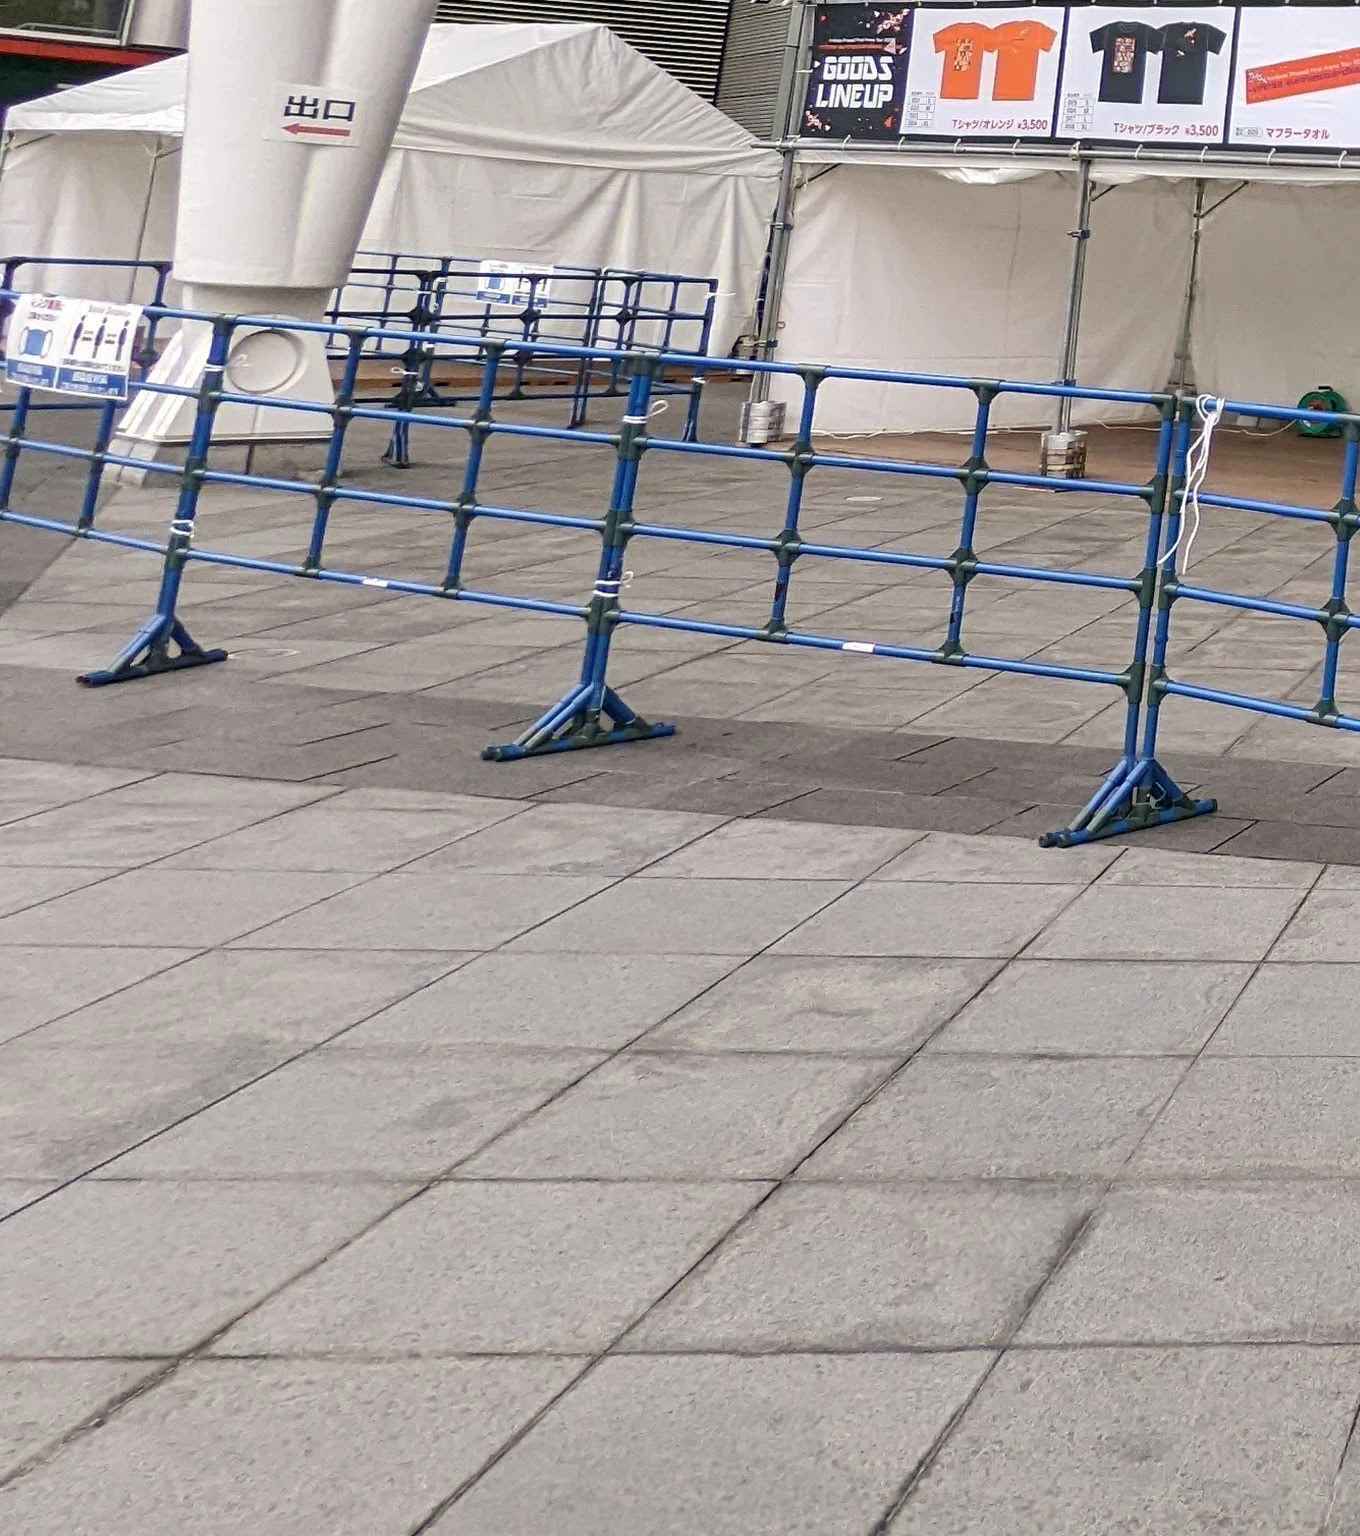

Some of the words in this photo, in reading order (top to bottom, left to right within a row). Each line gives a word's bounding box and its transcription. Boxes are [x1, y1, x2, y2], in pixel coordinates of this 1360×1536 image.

[823, 55, 894, 81] GOODS
[815, 83, 894, 109] LINEUP
[284, 95, 356, 122] 出口
[1017, 119, 1048, 130] ¥3,500
[1185, 124, 1219, 137] ¥3,500
[1266, 127, 1331, 140] マフラータオル
